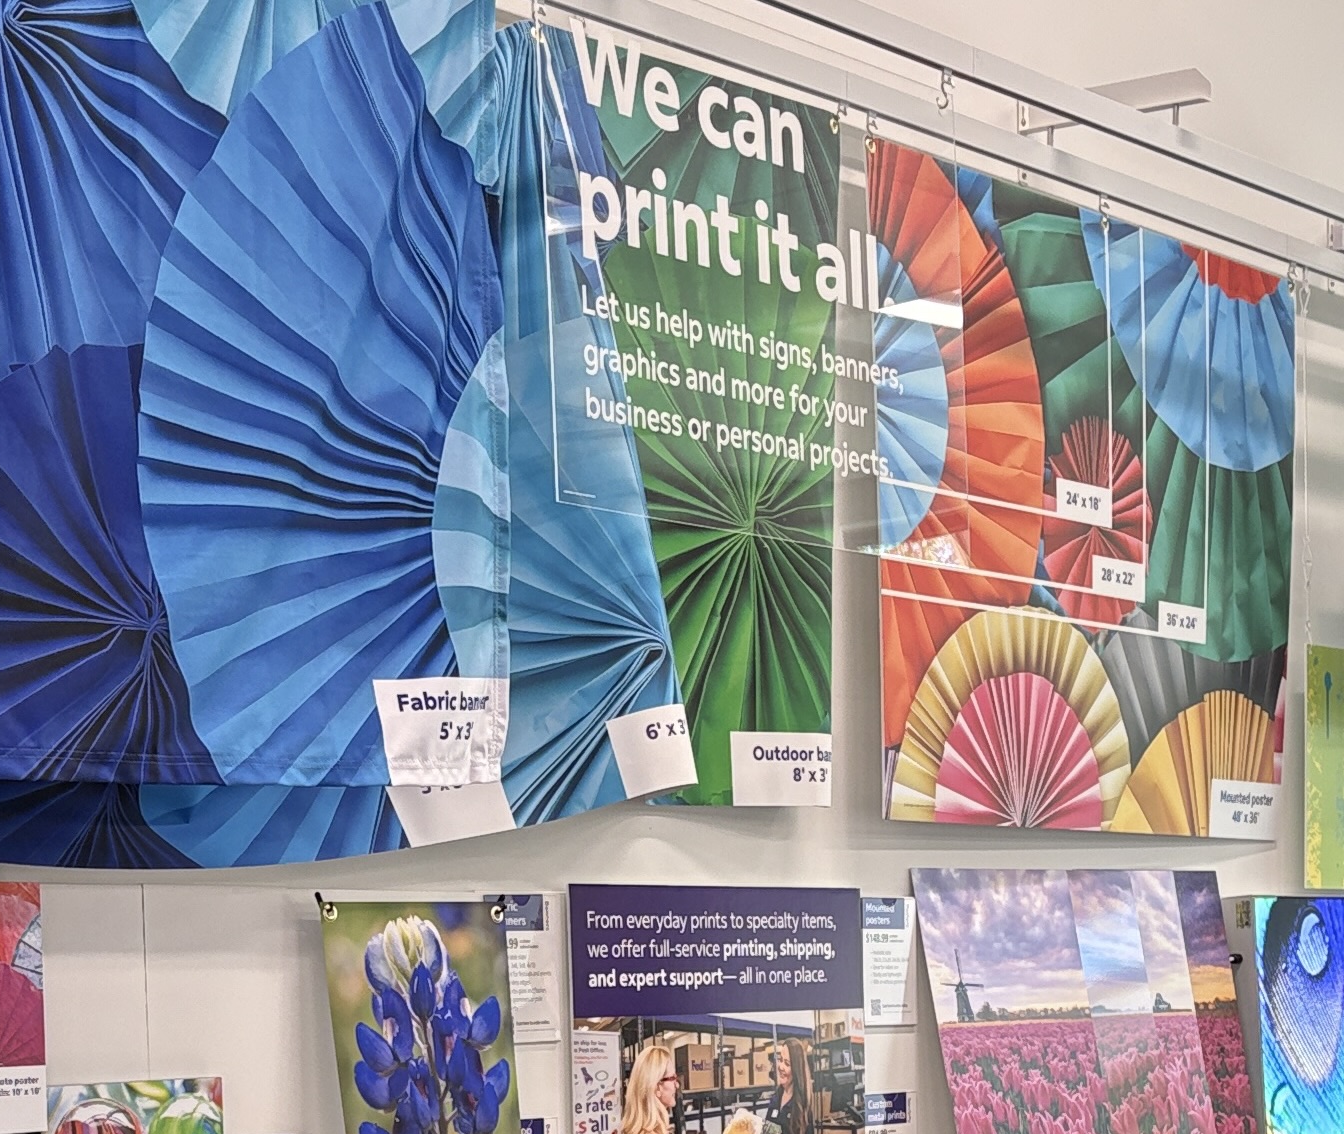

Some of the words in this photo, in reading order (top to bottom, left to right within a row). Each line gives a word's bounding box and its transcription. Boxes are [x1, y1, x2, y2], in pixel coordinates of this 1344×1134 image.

[569, 18, 681, 133] We
[697, 82, 806, 174] can
[578, 168, 743, 284] print
[756, 199, 803, 294] it
[815, 228, 895, 318] all.
[582, 285, 620, 321] Let
[625, 303, 651, 329] us
[656, 302, 703, 350] help
[708, 320, 754, 356] with
[759, 331, 817, 375] signs,
[822, 344, 904, 395] banners,
[583, 343, 681, 386] graphics
[685, 367, 726, 397] and
[731, 376, 785, 410] more
[789, 384, 820, 417] for
[824, 401, 868, 428] your
[585, 386, 683, 436] business
[688, 417, 711, 442] or
[716, 423, 805, 463] personal
[811, 442, 895, 478] projects.
[1081, 496, 1087, 508] x
[1115, 573, 1121, 584] x
[1179, 617, 1184, 628] x
[397, 690, 458, 712] Fabric
[439, 721, 453, 740] 5'
[455, 725, 463, 740] x
[645, 721, 661, 741] 6'
[667, 721, 677, 736] x
[752, 745, 811, 762] Outdoor
[793, 768, 805, 783] 8'
[808, 770, 817, 783] x
[587, 911, 624, 929] From
[626, 911, 687, 933] everyday
[690, 911, 727, 933] prints
[730, 913, 744, 929] to
[746, 911, 800, 933] specialty
[802, 912, 837, 931] items,
[587, 943, 609, 958] we
[611, 939, 647, 958] offer
[649, 939, 720, 958] full-service
[723, 939, 778, 961] printing,
[779, 938, 836, 960] shipping,
[588, 968, 617, 987] and
[619, 969, 667, 991] expert
[739, 966, 753, 984] all
[755, 967, 766, 984] in
[769, 971, 792, 984] one
[794, 966, 828, 987] place.
[585, 1098, 613, 1114] rate
